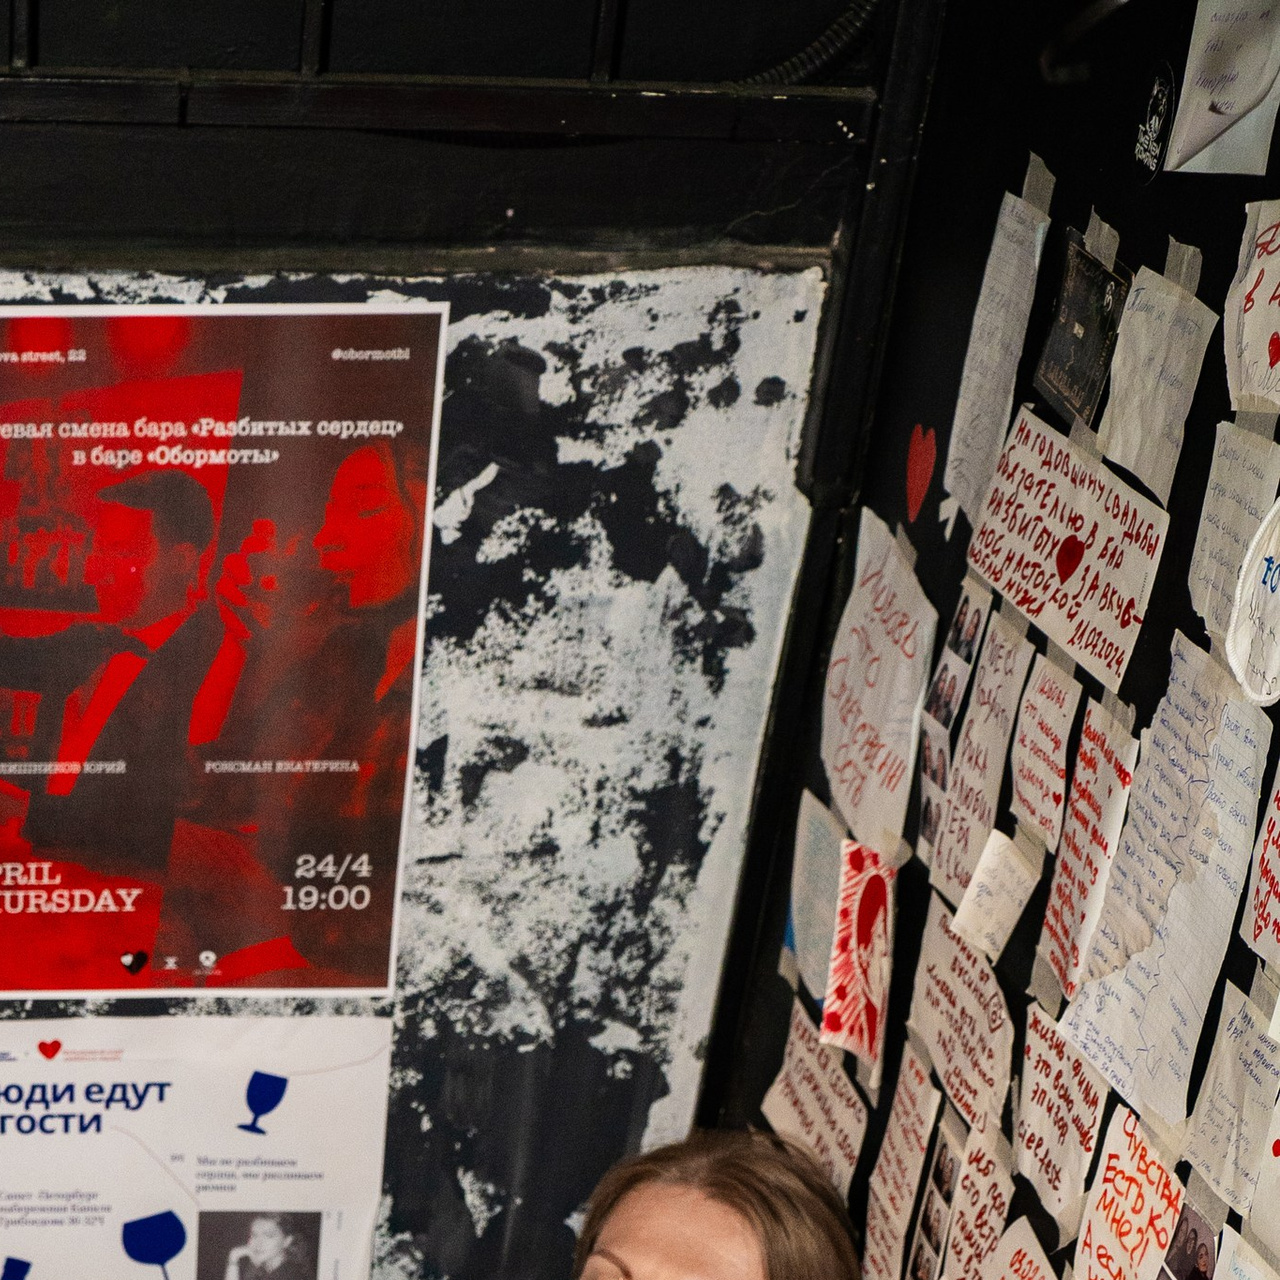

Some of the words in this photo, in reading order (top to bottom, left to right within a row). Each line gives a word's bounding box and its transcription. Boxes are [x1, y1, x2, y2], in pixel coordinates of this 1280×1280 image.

[21, 350, 67, 363] street,
[69, 350, 87, 362] 22
[58, 420, 130, 439] смена
[134, 418, 187, 441] бара
[191, 418, 312, 439] «Разбитых
[316, 419, 404, 441] сердец»
[73, 450, 87, 466] в
[91, 447, 144, 467] баре
[147, 447, 279, 467] «Обормоты»
[987, 487, 1060, 561] РАЗБИТЫХ
[83, 759, 126, 775] ЮРИЙ
[295, 854, 373, 880] 24/4
[281, 885, 371, 912] 19:00
[85, 1080, 171, 1108] едут
